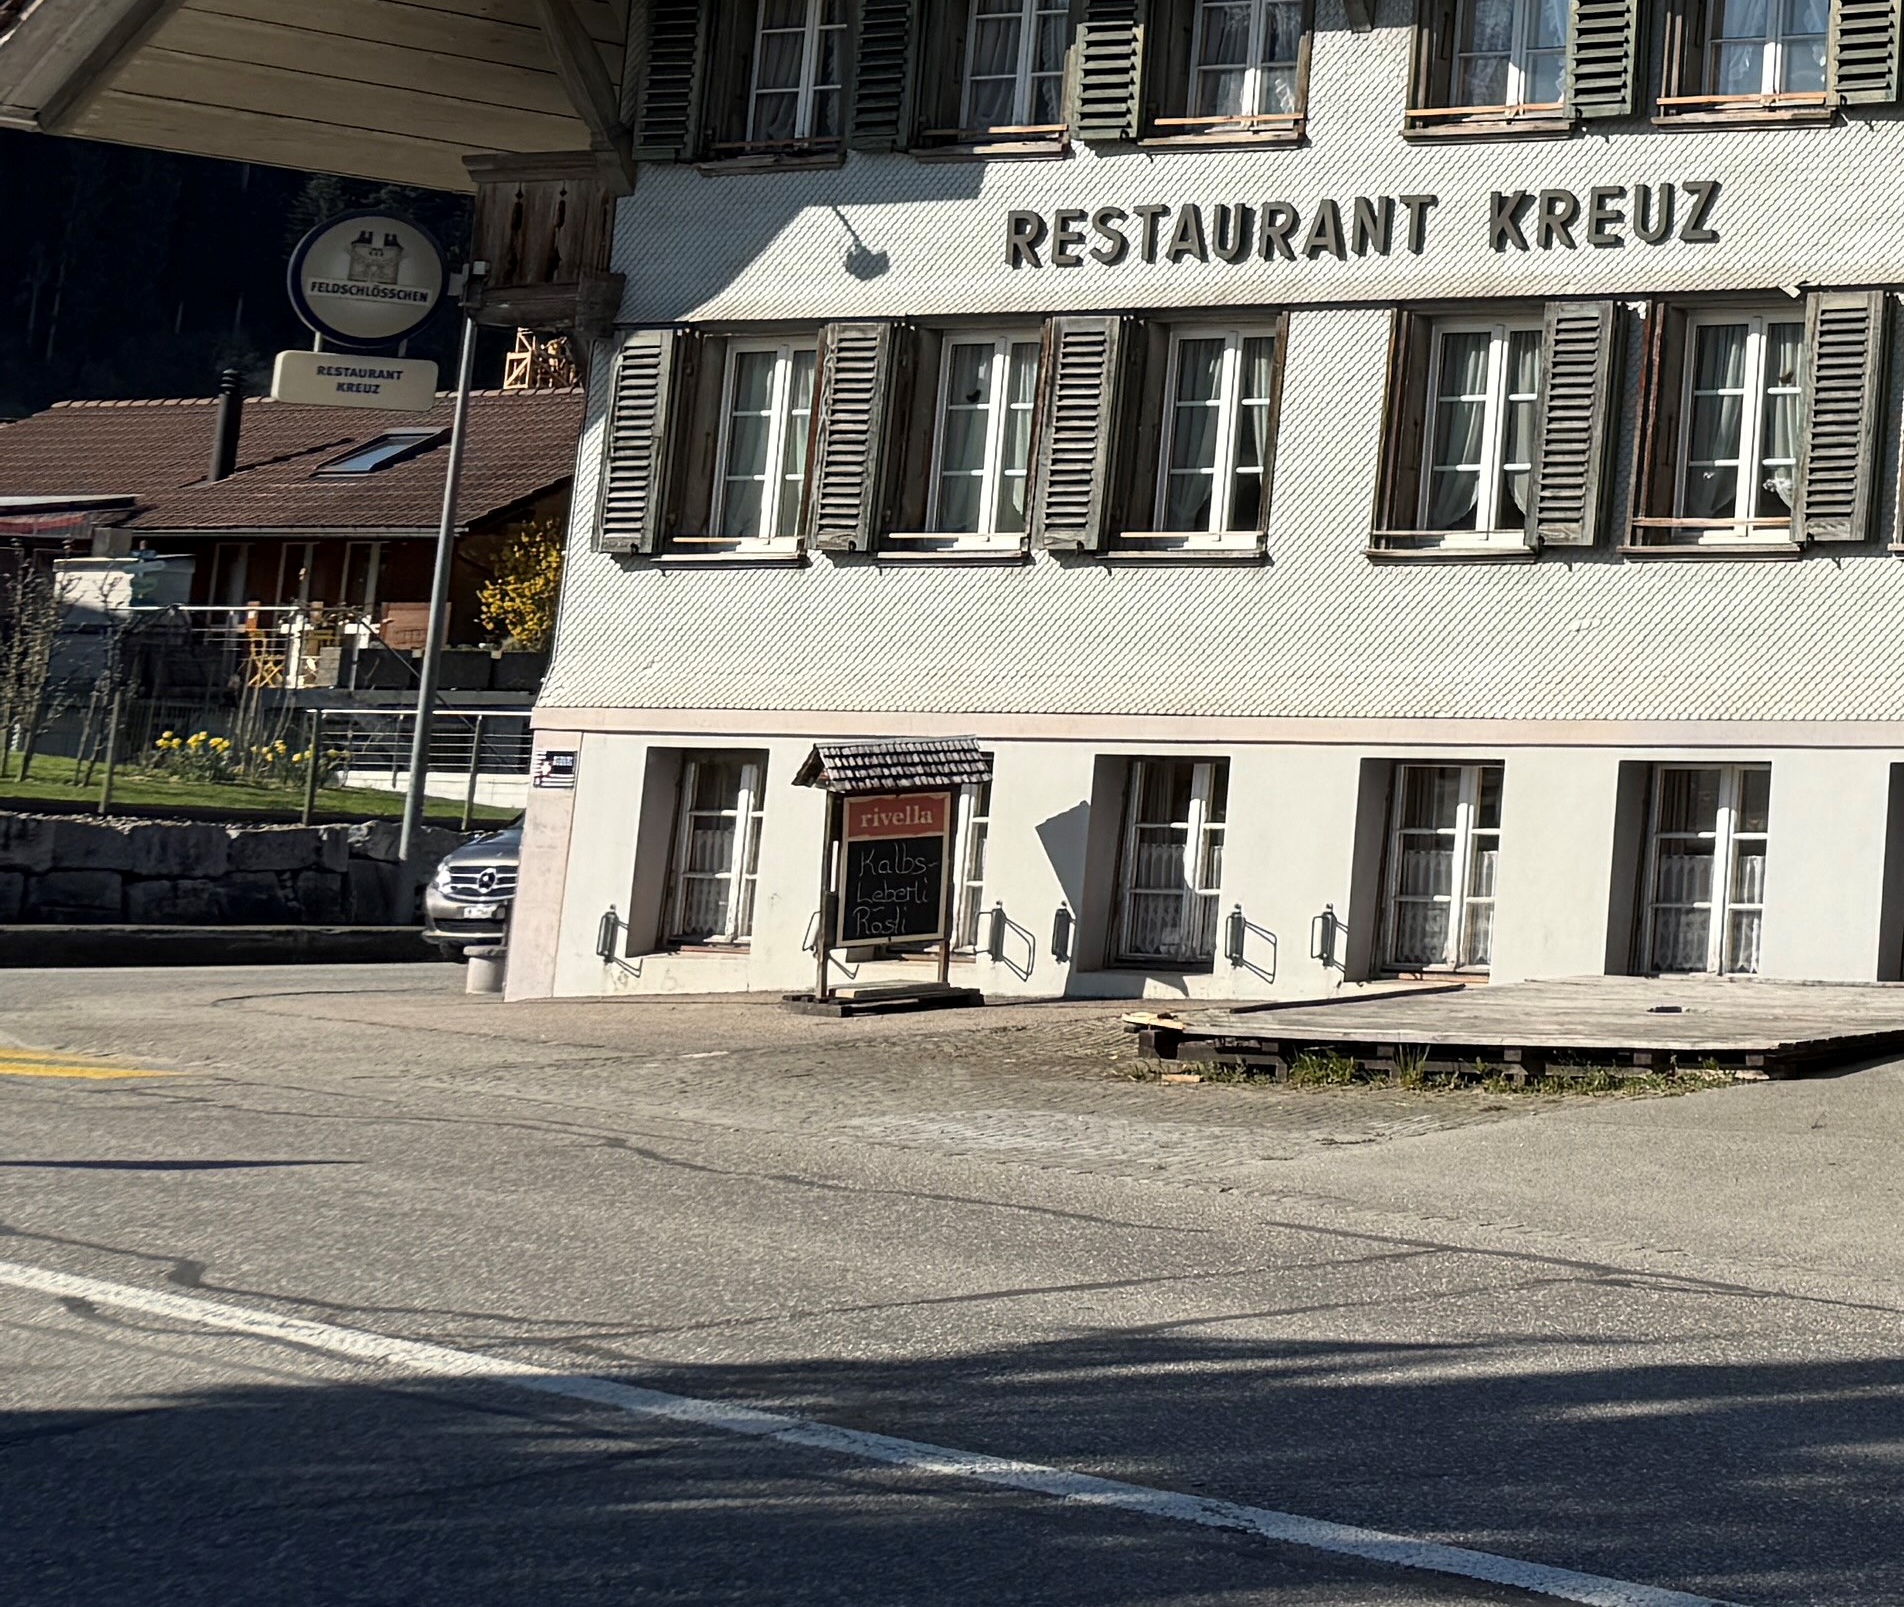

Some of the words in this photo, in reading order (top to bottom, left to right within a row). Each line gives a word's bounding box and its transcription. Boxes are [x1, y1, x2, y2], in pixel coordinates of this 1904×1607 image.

[1005, 194, 1438, 269] RESTAURANT
[1489, 180, 1722, 251] KREUZ
[310, 281, 429, 303] FELDSCHLÖSSCHEN
[316, 365, 404, 380] RESTAURANT
[336, 382, 381, 394] KREUZ
[860, 805, 933, 828] rivella
[859, 842, 938, 877] Kalbs-
[857, 877, 928, 904] Leberli
